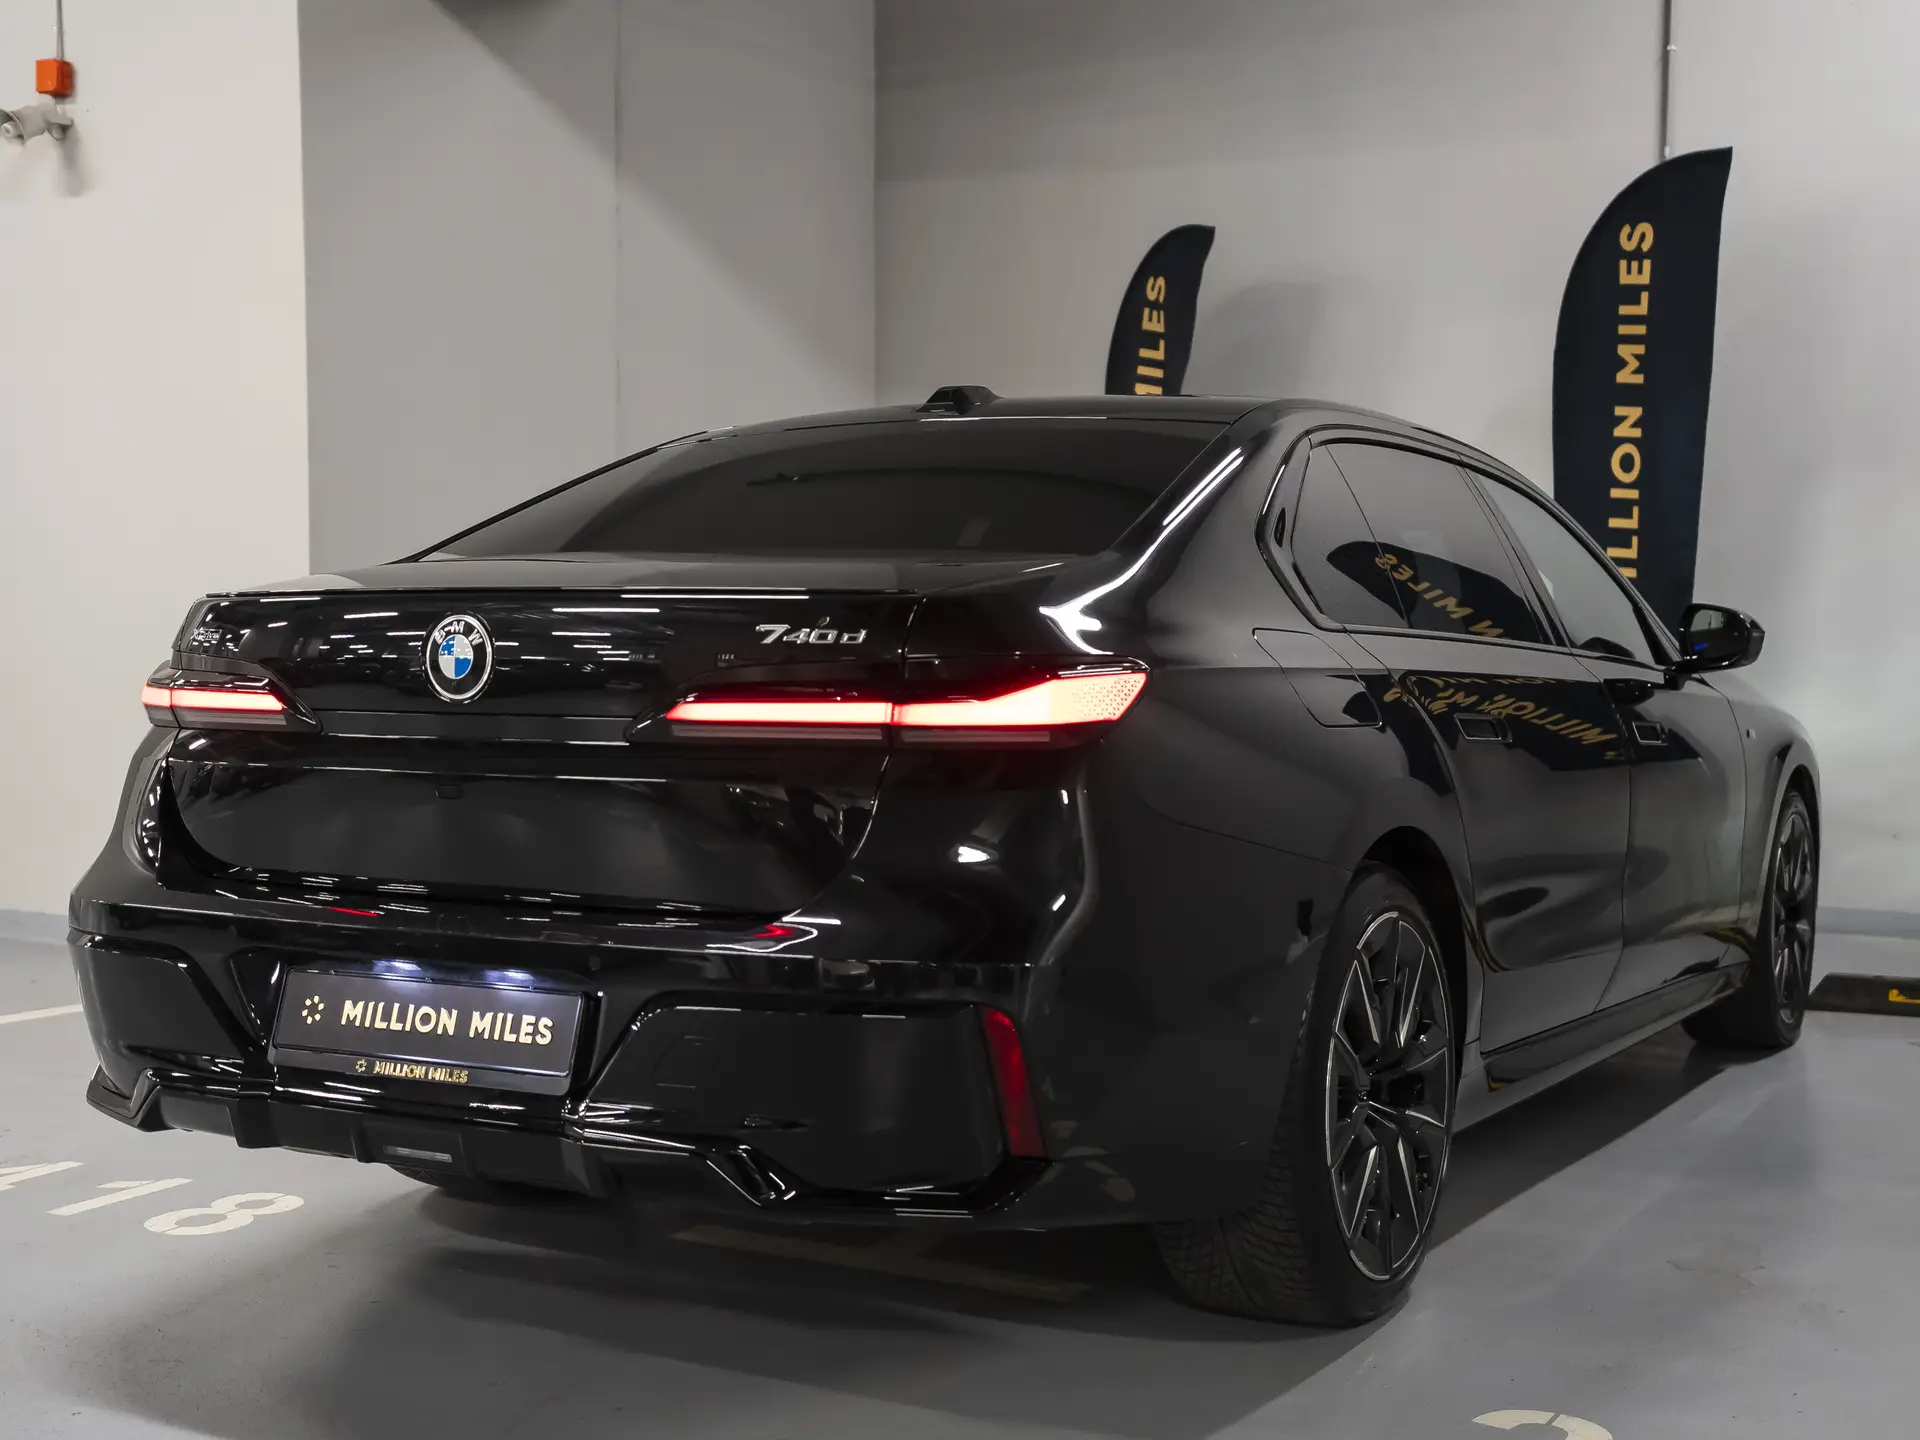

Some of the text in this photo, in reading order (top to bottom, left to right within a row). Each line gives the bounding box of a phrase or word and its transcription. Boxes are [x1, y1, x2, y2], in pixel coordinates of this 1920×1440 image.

[1607, 221, 1654, 579] ILLION MILES
[434, 620, 484, 646] BMW
[340, 999, 554, 1046] MILLION MILES
[373, 1060, 469, 1084] MILLION MILES
